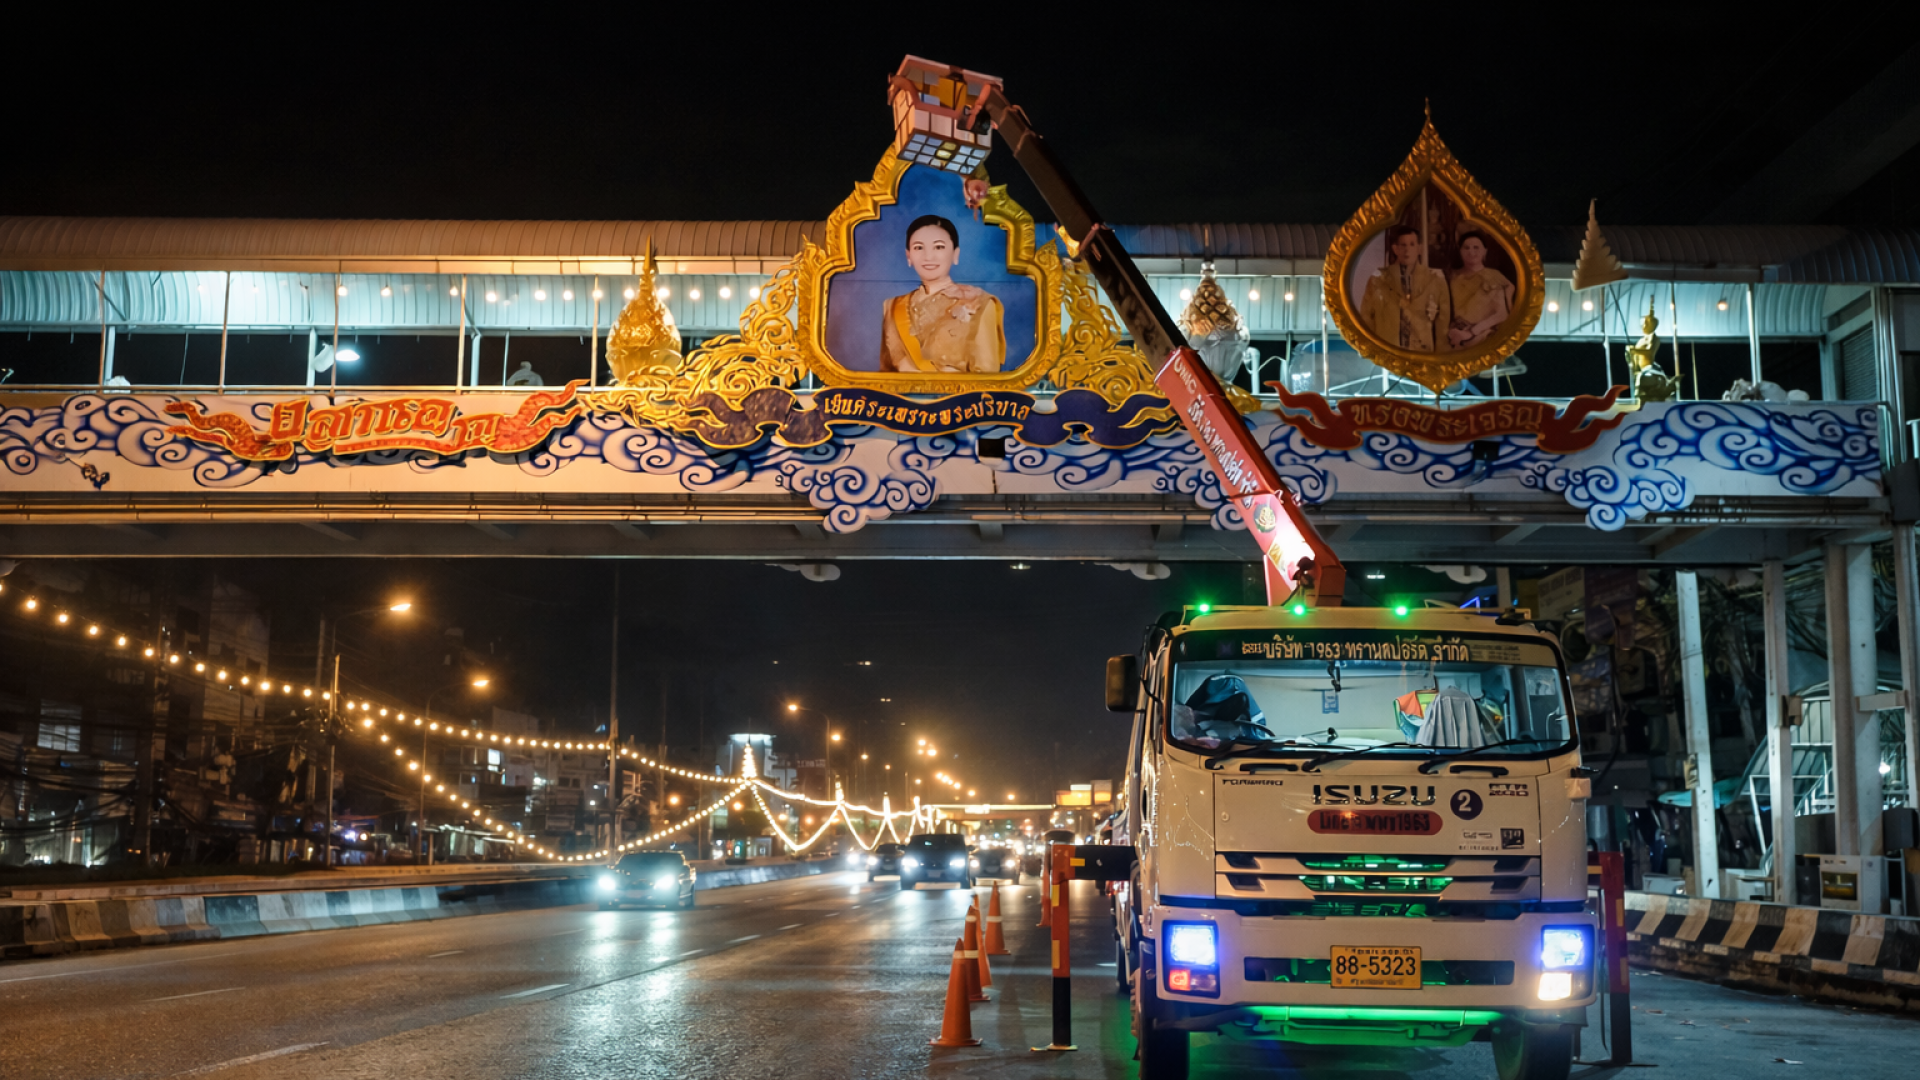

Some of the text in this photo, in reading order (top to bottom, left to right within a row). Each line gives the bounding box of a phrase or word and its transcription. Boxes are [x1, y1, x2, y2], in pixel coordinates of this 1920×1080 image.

[1264, 633, 1304, 659] บริษัท
[1312, 784, 1437, 806] ISUZU
[1458, 791, 1473, 812] 2
[1336, 955, 1416, 976] 88-5323
